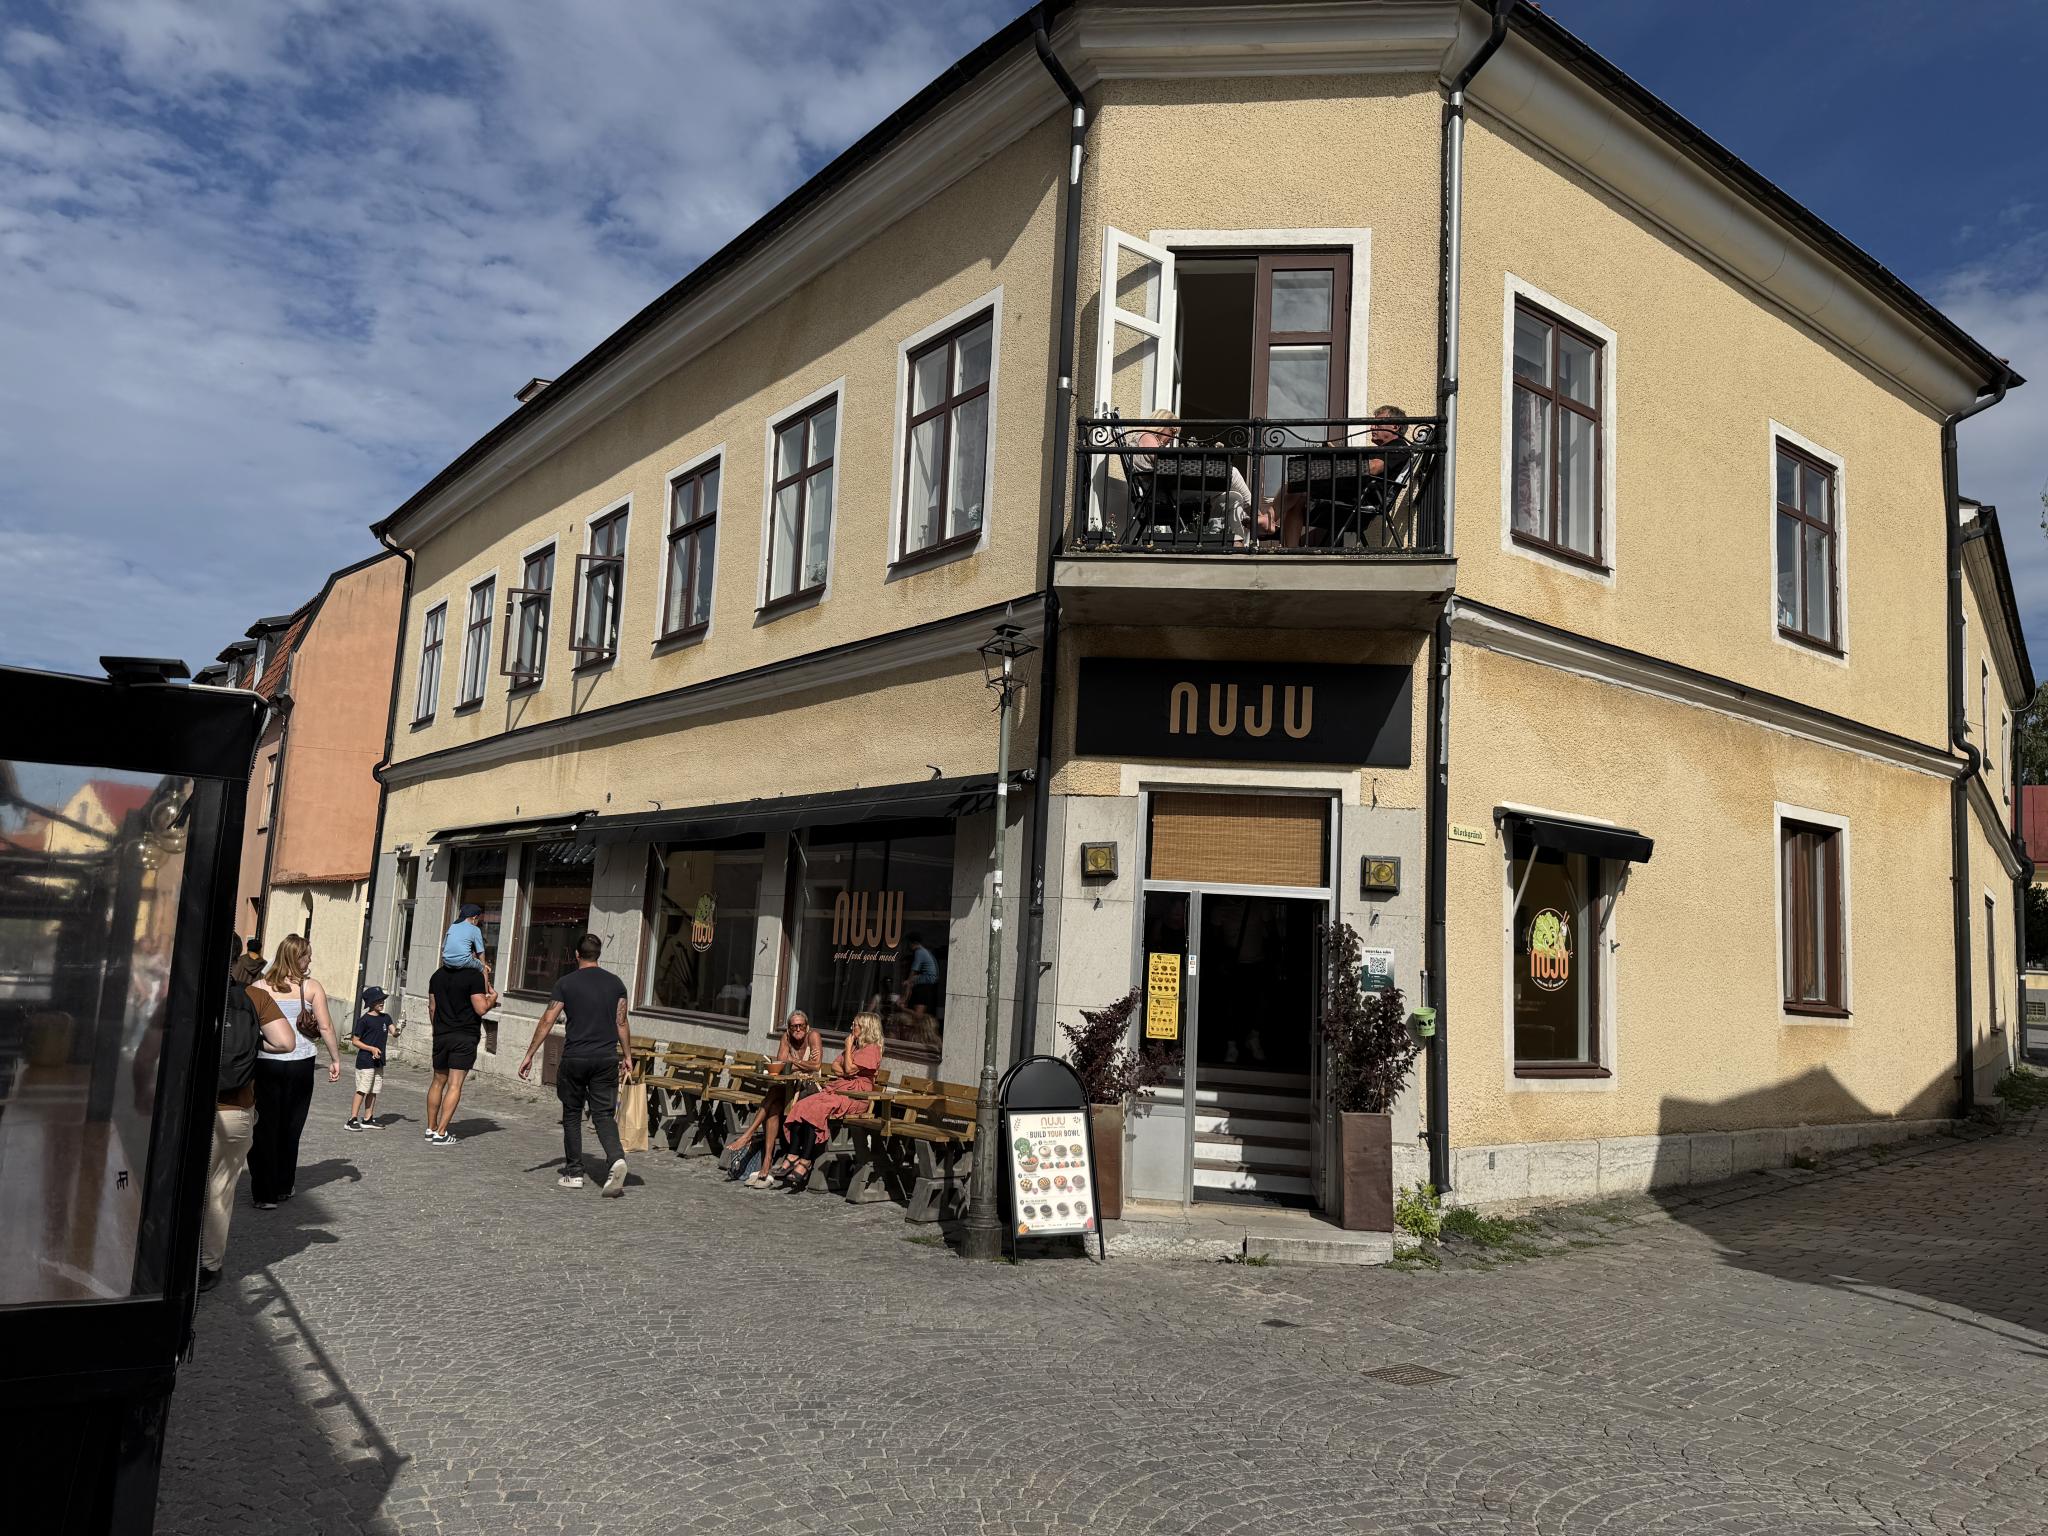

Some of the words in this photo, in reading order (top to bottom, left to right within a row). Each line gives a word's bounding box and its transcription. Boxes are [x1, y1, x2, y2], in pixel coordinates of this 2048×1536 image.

[1169, 681, 1313, 738] NUJU
[832, 891, 904, 948] NUJU
[1047, 1130, 1062, 1138] YOUR
